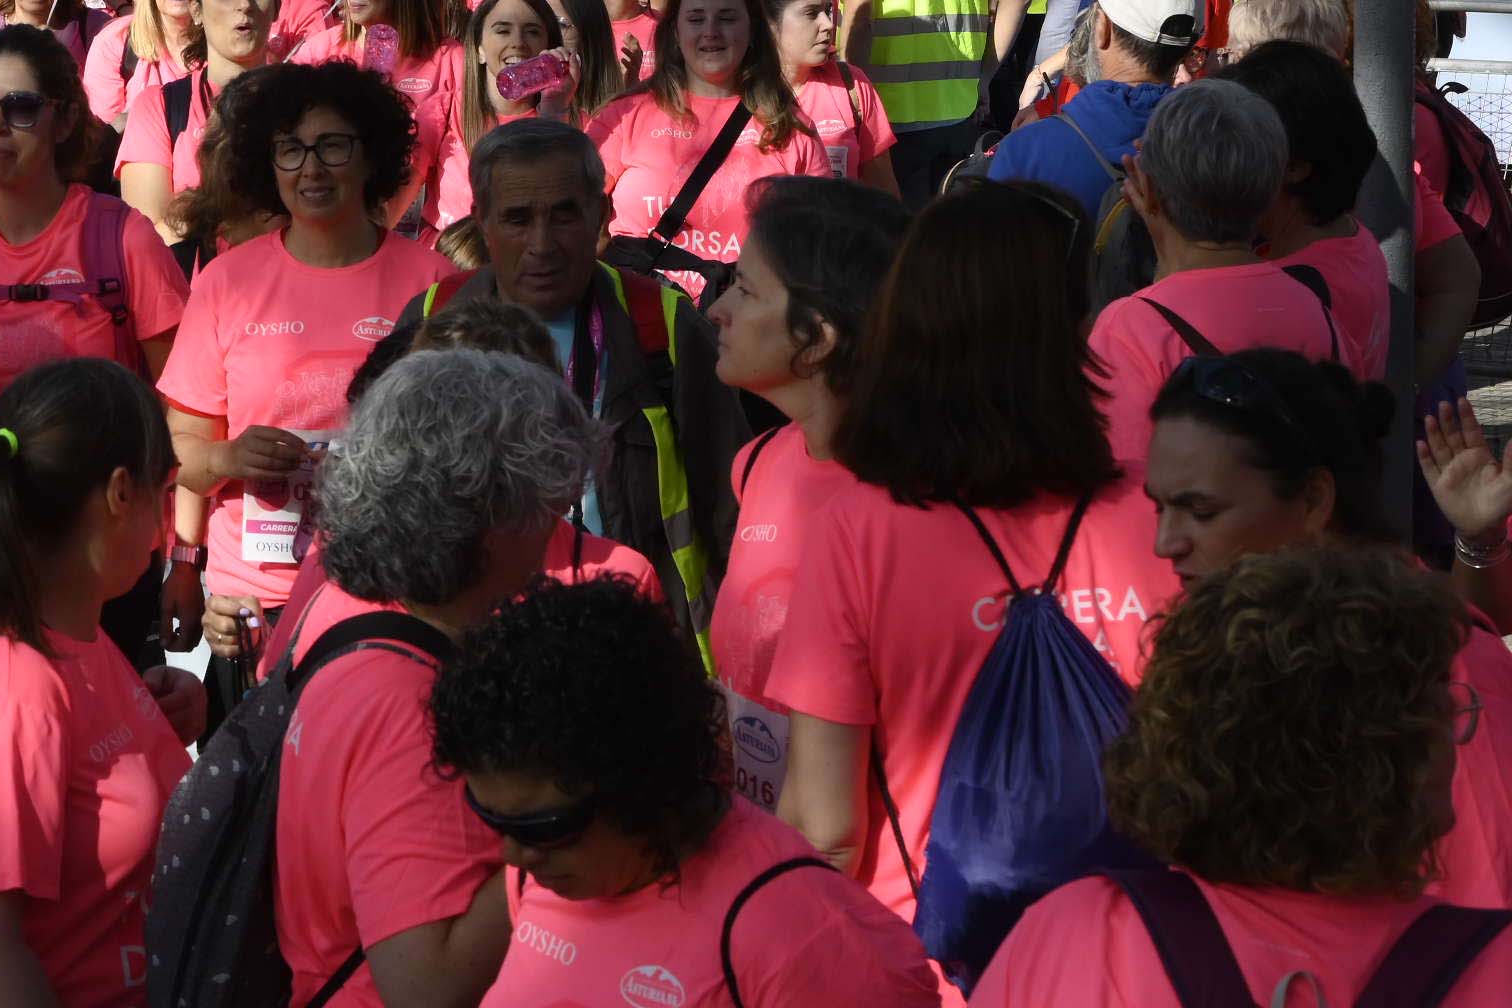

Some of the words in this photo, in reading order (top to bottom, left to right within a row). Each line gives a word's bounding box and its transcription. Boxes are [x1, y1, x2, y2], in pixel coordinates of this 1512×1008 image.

[648, 228, 741, 257] ORSA
[245, 320, 305, 336] OYSHO
[972, 585, 1149, 632] CERA
[737, 766, 775, 805] 016
[516, 920, 577, 966] OYSHO
[623, 975, 680, 1006] ASTURIANA
